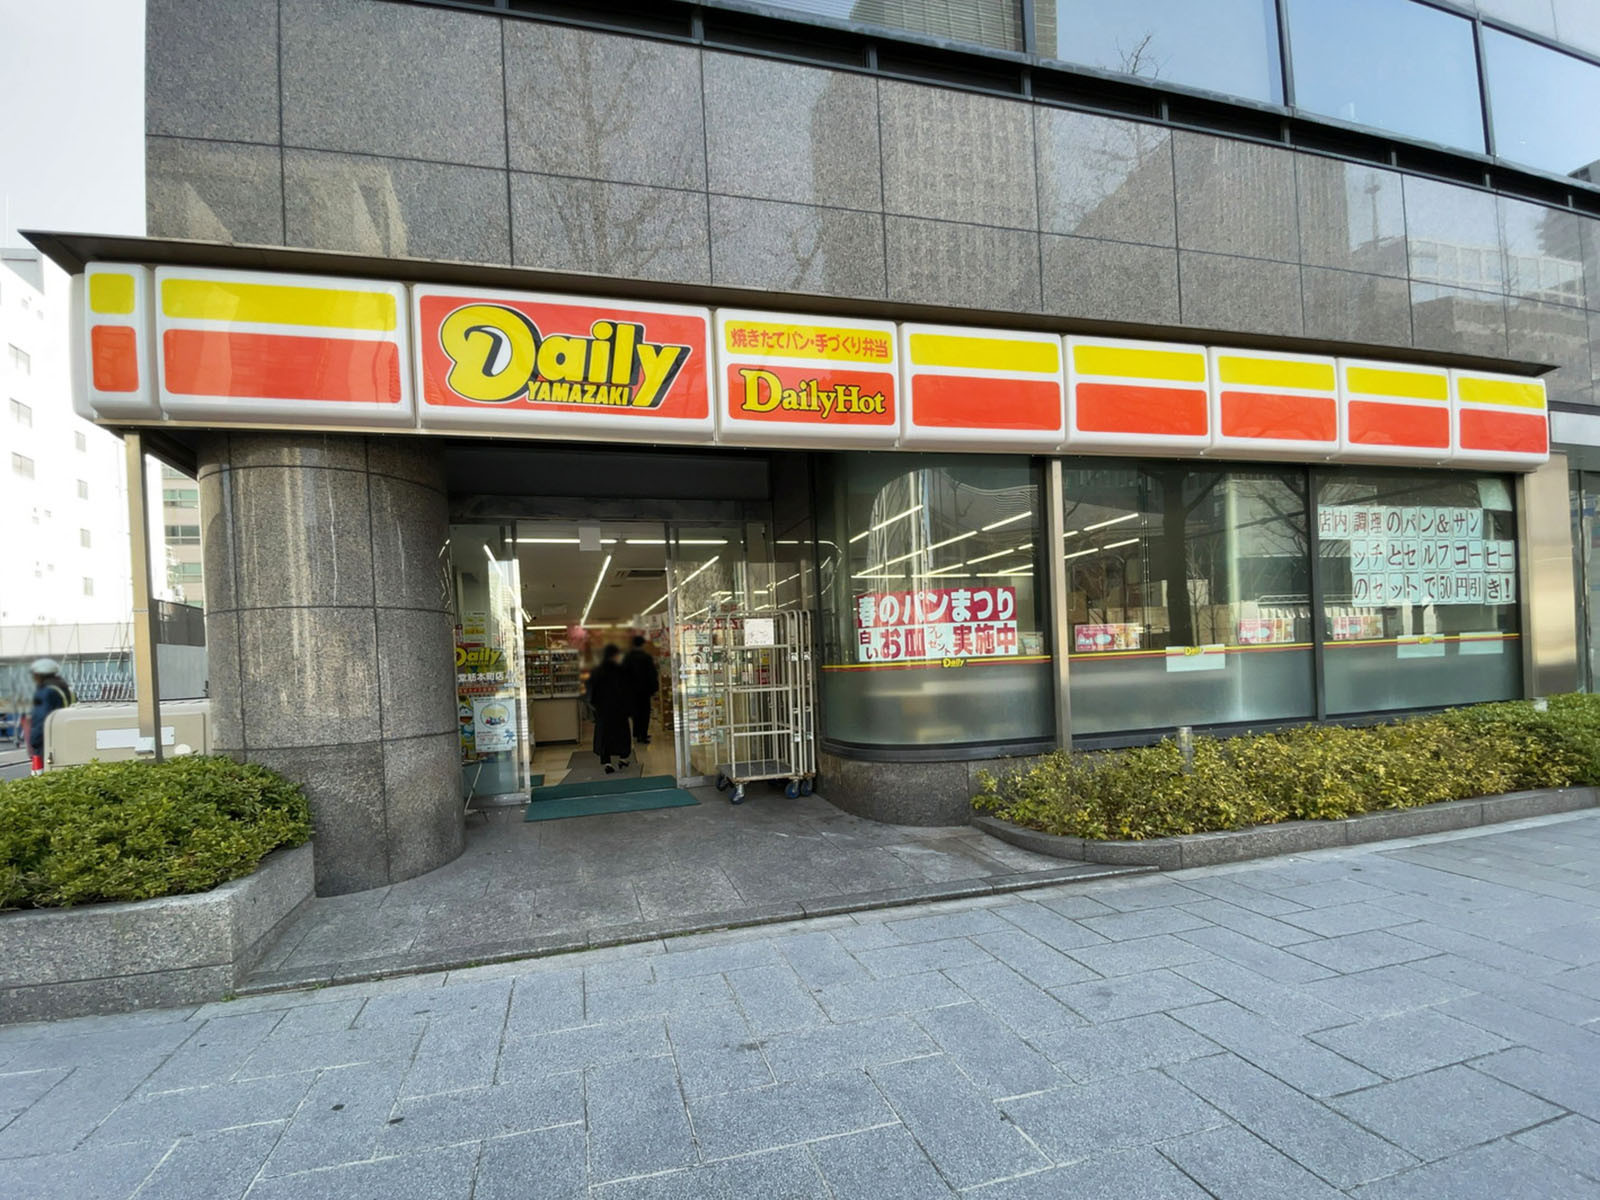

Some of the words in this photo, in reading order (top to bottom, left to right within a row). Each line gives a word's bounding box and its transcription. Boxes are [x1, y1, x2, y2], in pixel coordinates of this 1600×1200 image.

[439, 303, 691, 408] Daily
[731, 328, 888, 358] 焼きたてパン・手づくり弁当
[526, 380, 630, 407] YAMAZAKI
[1319, 510, 1480, 534] 店内調理のパン&サン
[1353, 543, 1512, 567] ッチとセルフコーヒー
[858, 588, 1014, 627] 春のパンまつり
